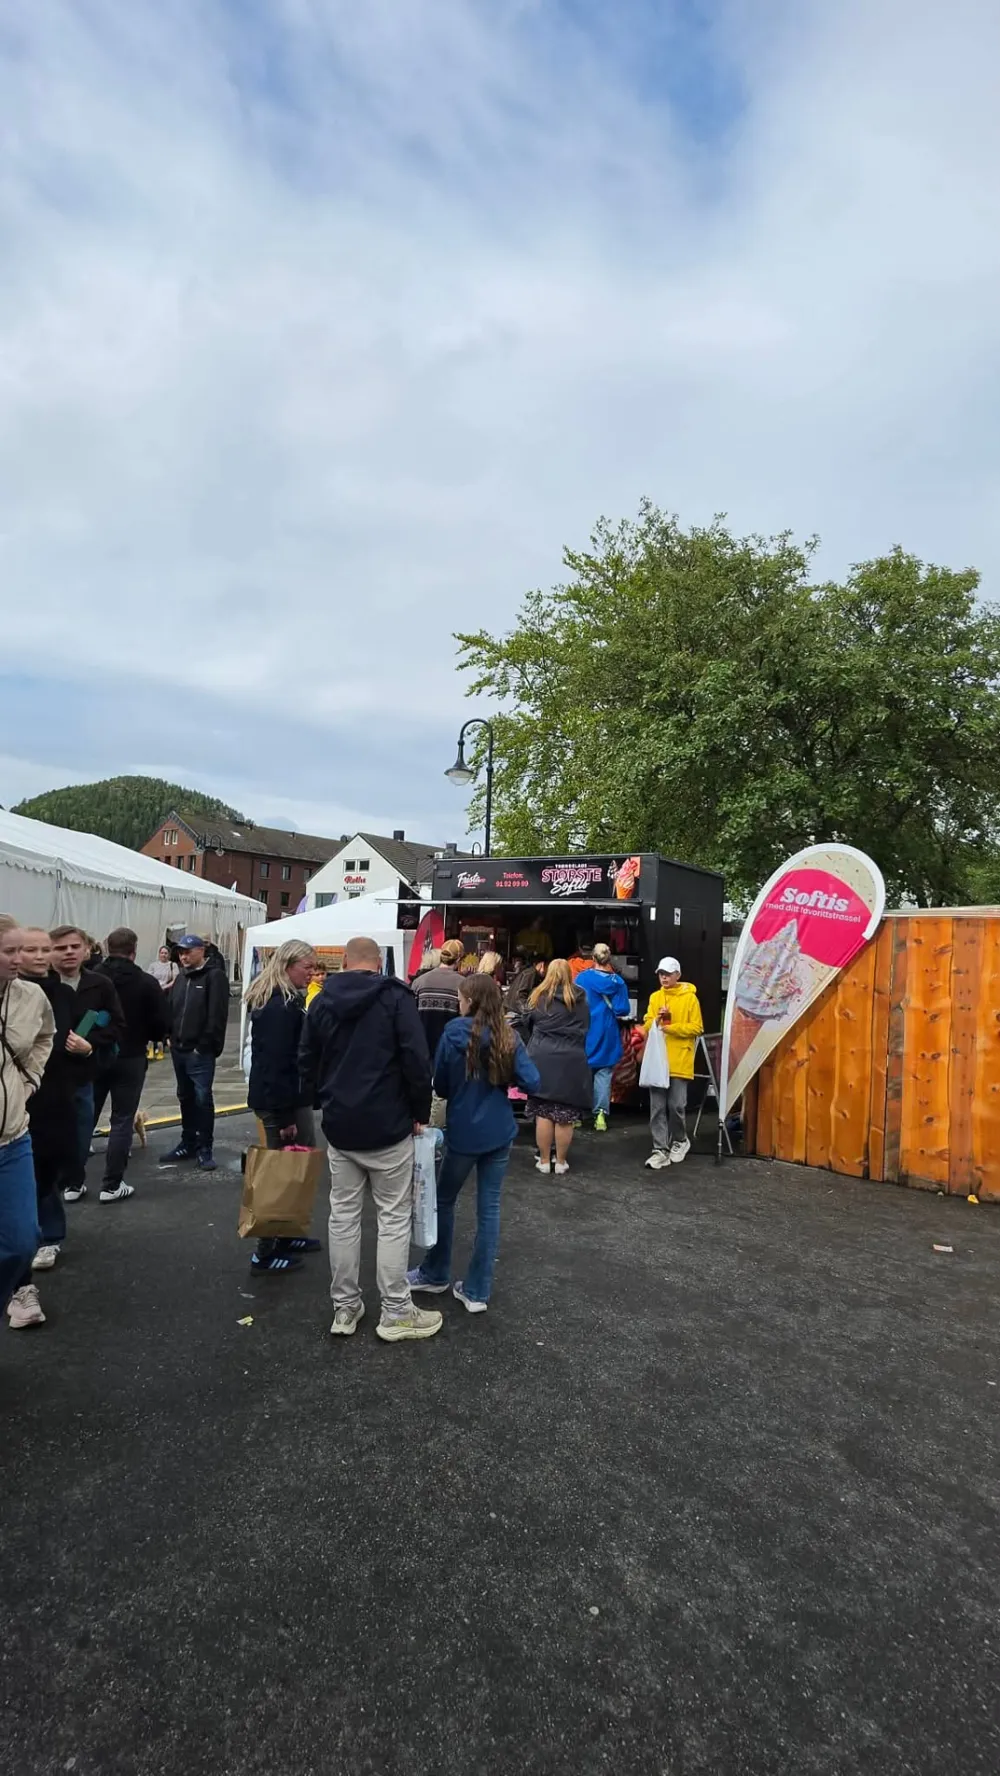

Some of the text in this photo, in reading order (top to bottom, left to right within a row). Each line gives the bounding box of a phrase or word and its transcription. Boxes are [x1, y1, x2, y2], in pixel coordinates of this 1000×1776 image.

[541, 868, 602, 882] STØRSTE
[780, 887, 849, 912] Softis
[766, 902, 784, 910] med
[785, 905, 800, 913] ditt
